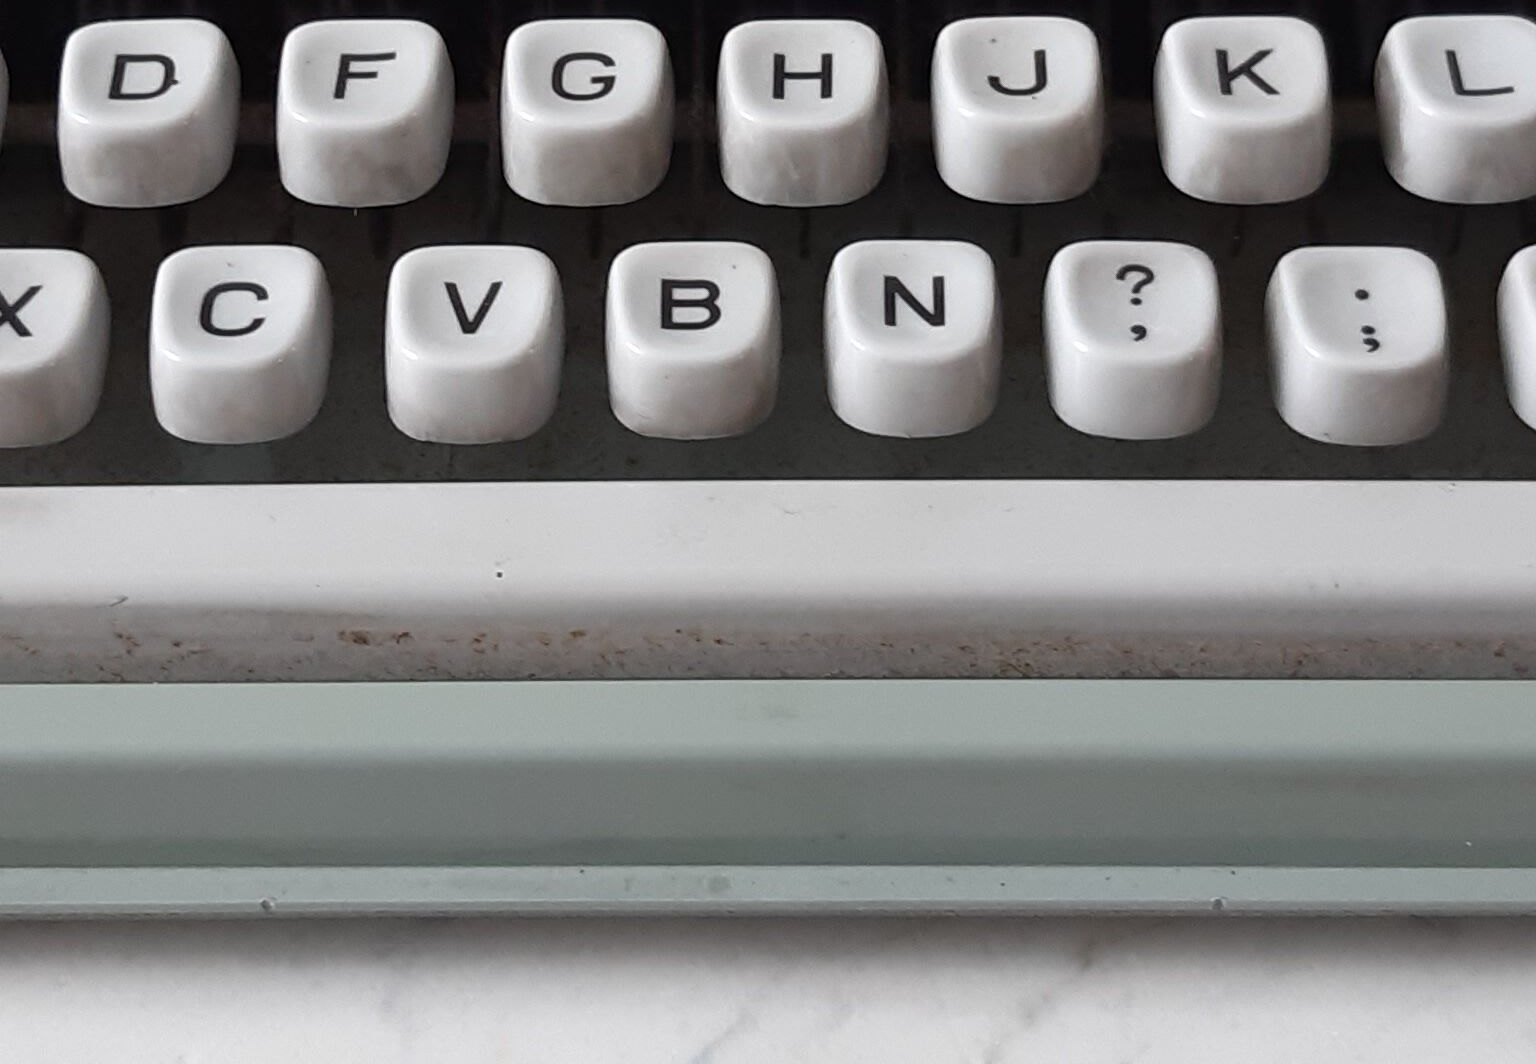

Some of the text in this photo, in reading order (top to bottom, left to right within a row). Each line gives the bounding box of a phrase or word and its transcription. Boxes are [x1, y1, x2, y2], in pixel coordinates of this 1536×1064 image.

[108, 54, 178, 100] D
[333, 53, 396, 99] F
[552, 52, 615, 101] G
[772, 53, 832, 99] H
[987, 50, 1047, 96] J
[1216, 49, 1279, 95] K
[1445, 50, 1514, 96] L
[661, 279, 721, 330] B
[884, 276, 945, 326] N
[1116, 264, 1154, 305] ?
[198, 282, 268, 336] C
[444, 282, 502, 334] V
[1361, 326, 1380, 352] ;
